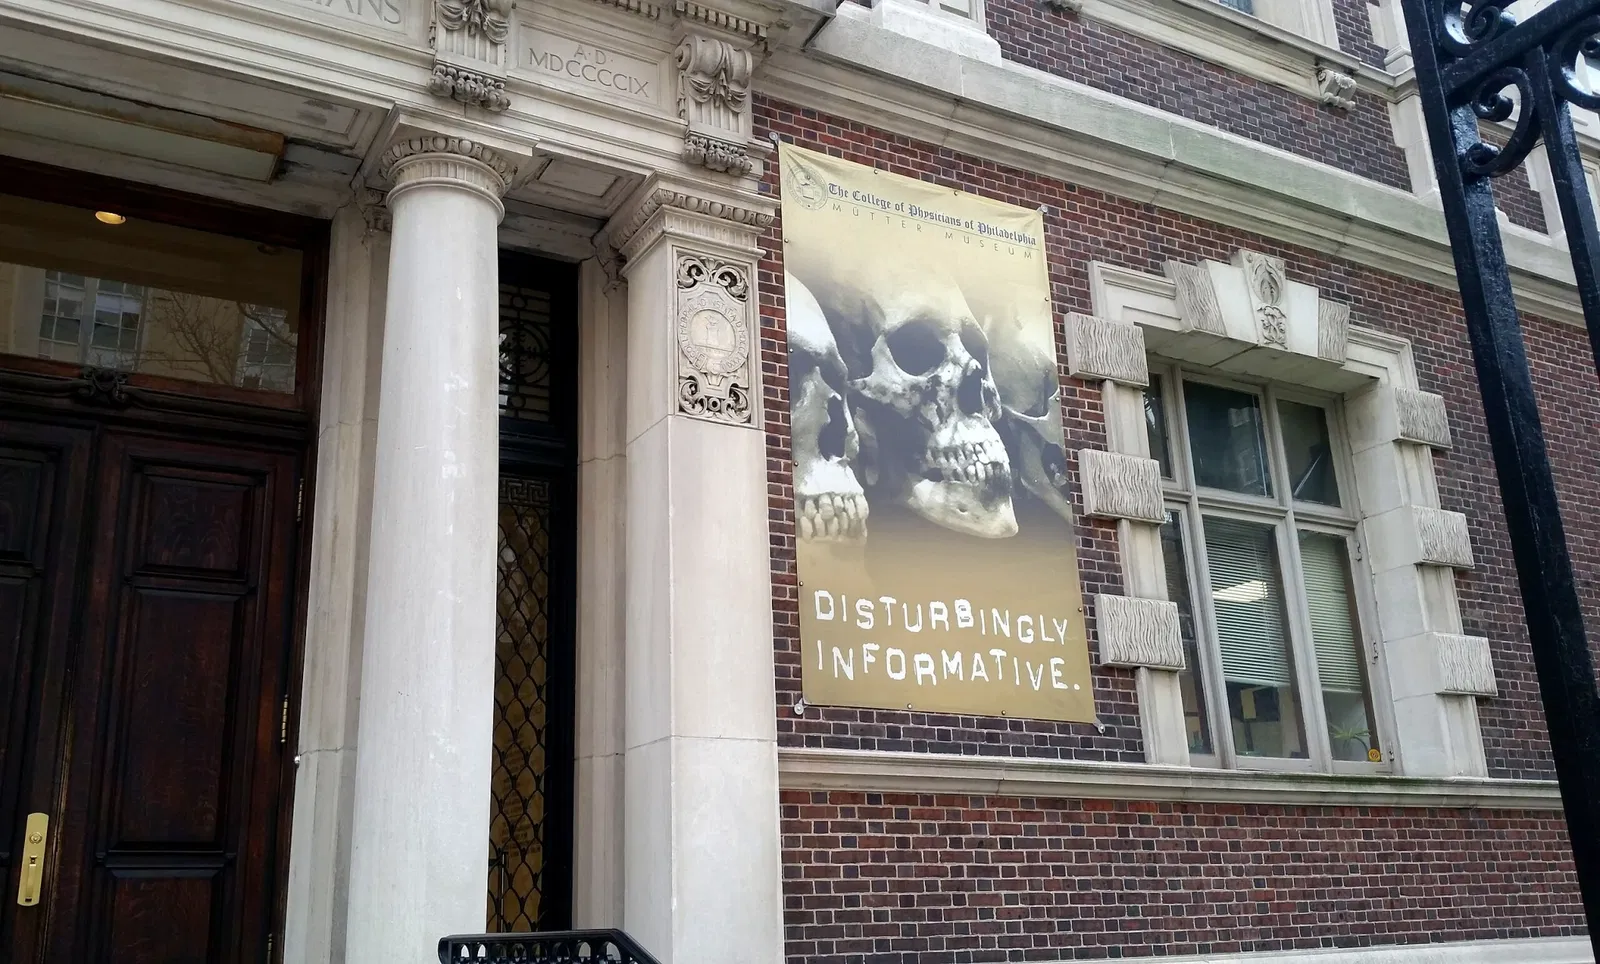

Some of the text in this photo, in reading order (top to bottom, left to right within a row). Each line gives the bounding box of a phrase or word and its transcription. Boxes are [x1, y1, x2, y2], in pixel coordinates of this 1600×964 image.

[529, 47, 649, 98] MDCCCCIX
[828, 183, 1037, 245] The College of Physicians of Philadelphia
[944, 232, 1032, 260] MUSEUM
[814, 590, 1068, 645] DISTURBINGLY
[816, 639, 1081, 691] INFORMATIVE.
